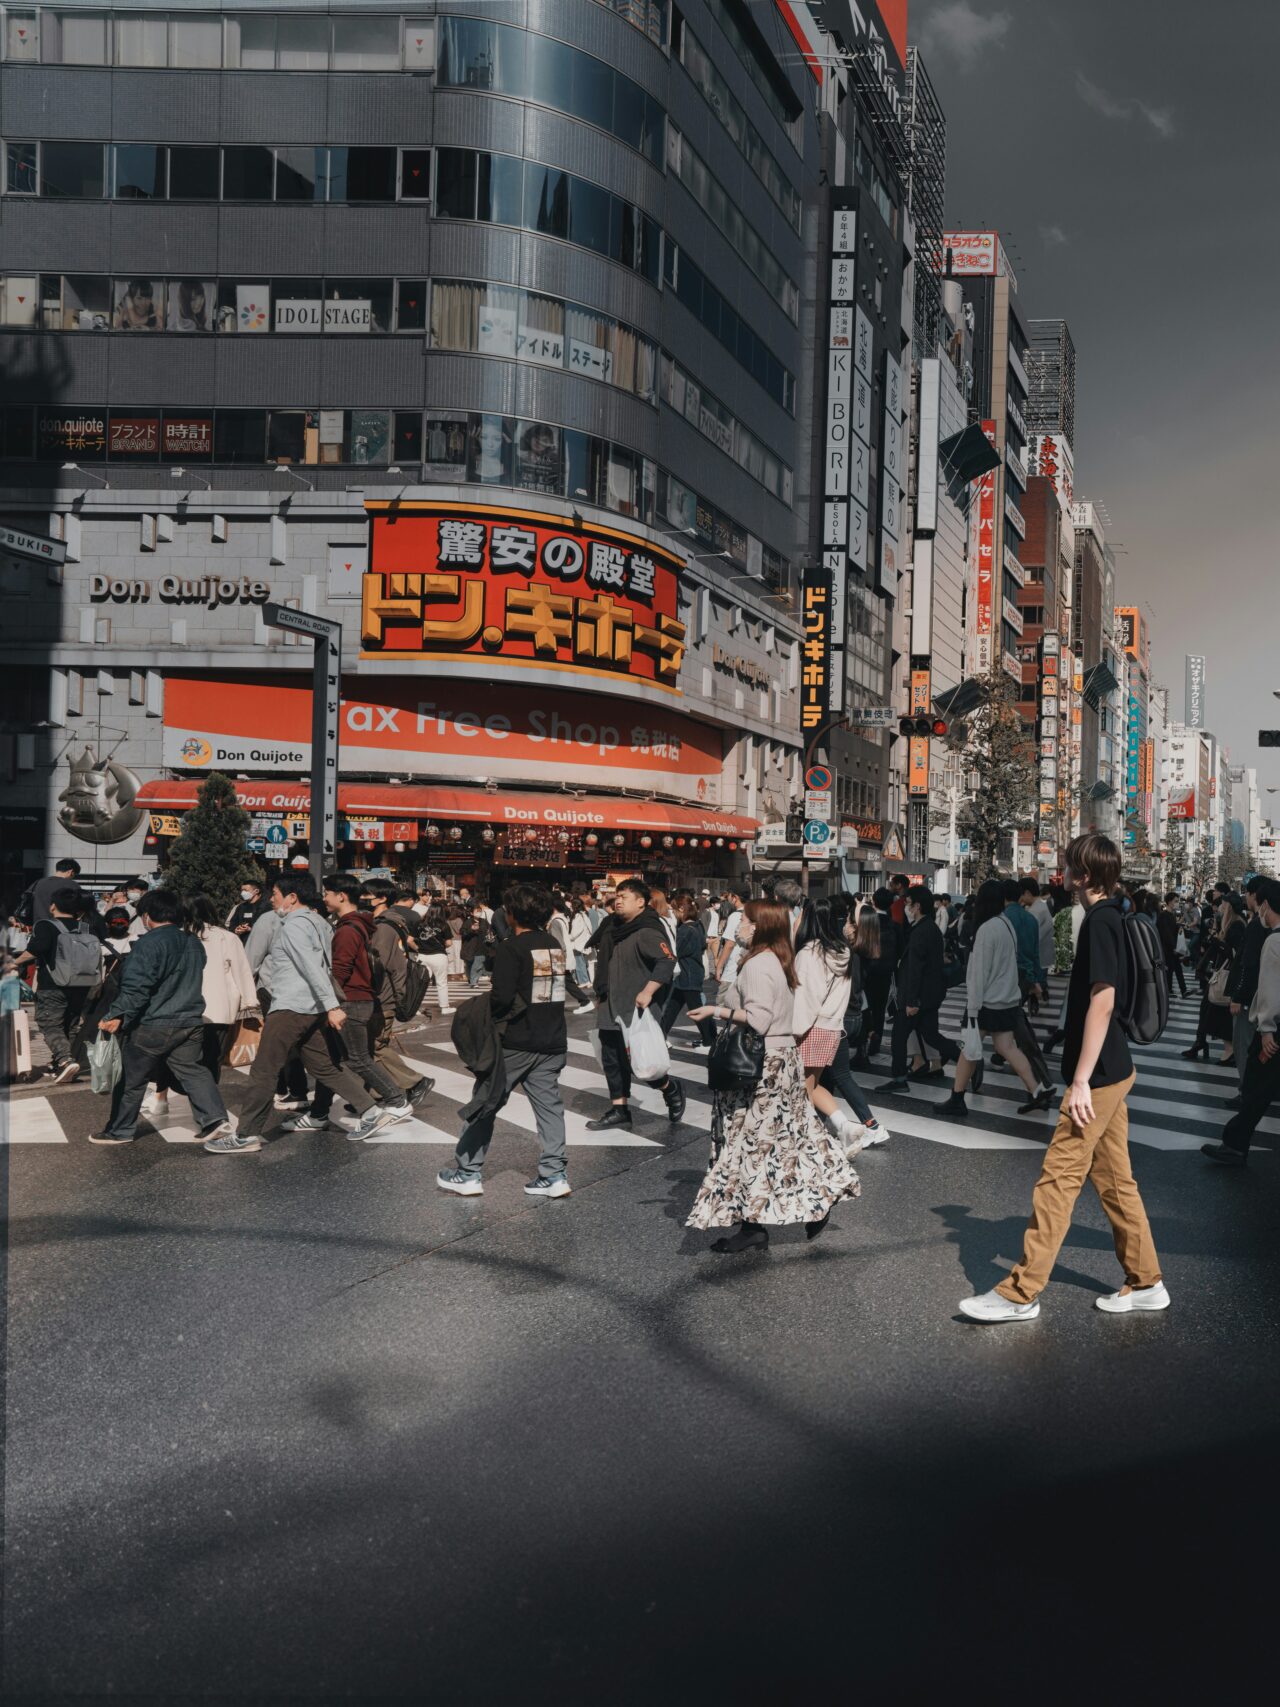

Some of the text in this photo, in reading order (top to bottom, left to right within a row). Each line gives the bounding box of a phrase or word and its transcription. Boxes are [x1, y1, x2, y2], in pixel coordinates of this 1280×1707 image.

[839, 213, 849, 250] 6年4組
[837, 263, 848, 297] おかか
[277, 307, 370, 325] IDOL STAGE
[840, 310, 848, 335] 北海道
[516, 333, 612, 376] アイドル ステージ
[40, 416, 104, 436] don.quijote
[111, 424, 156, 438] ブランド
[166, 424, 210, 439] 時計
[831, 354, 846, 490] KIBORI
[112, 438, 155, 450] BRAND
[166, 439, 209, 451] WATCH
[437, 520, 656, 598] 驚安の殿堂
[979, 518, 994, 583] パセラ
[89, 573, 271, 609] Don Quijote
[279, 611, 331, 633] CENTRAL ROAD
[341, 700, 680, 762] ax Free Shop 免税店
[217, 748, 303, 765] Don Quijote
[324, 674, 338, 822] ゴジラロード
[236, 794, 269, 807] Don
[504, 806, 604, 825] Don Quijote
[293, 823, 305, 836] ド
[354, 827, 380, 839] 免税
[702, 820, 715, 831] Don
[810, 825, 820, 841] P
[961, 841, 967, 852] P
